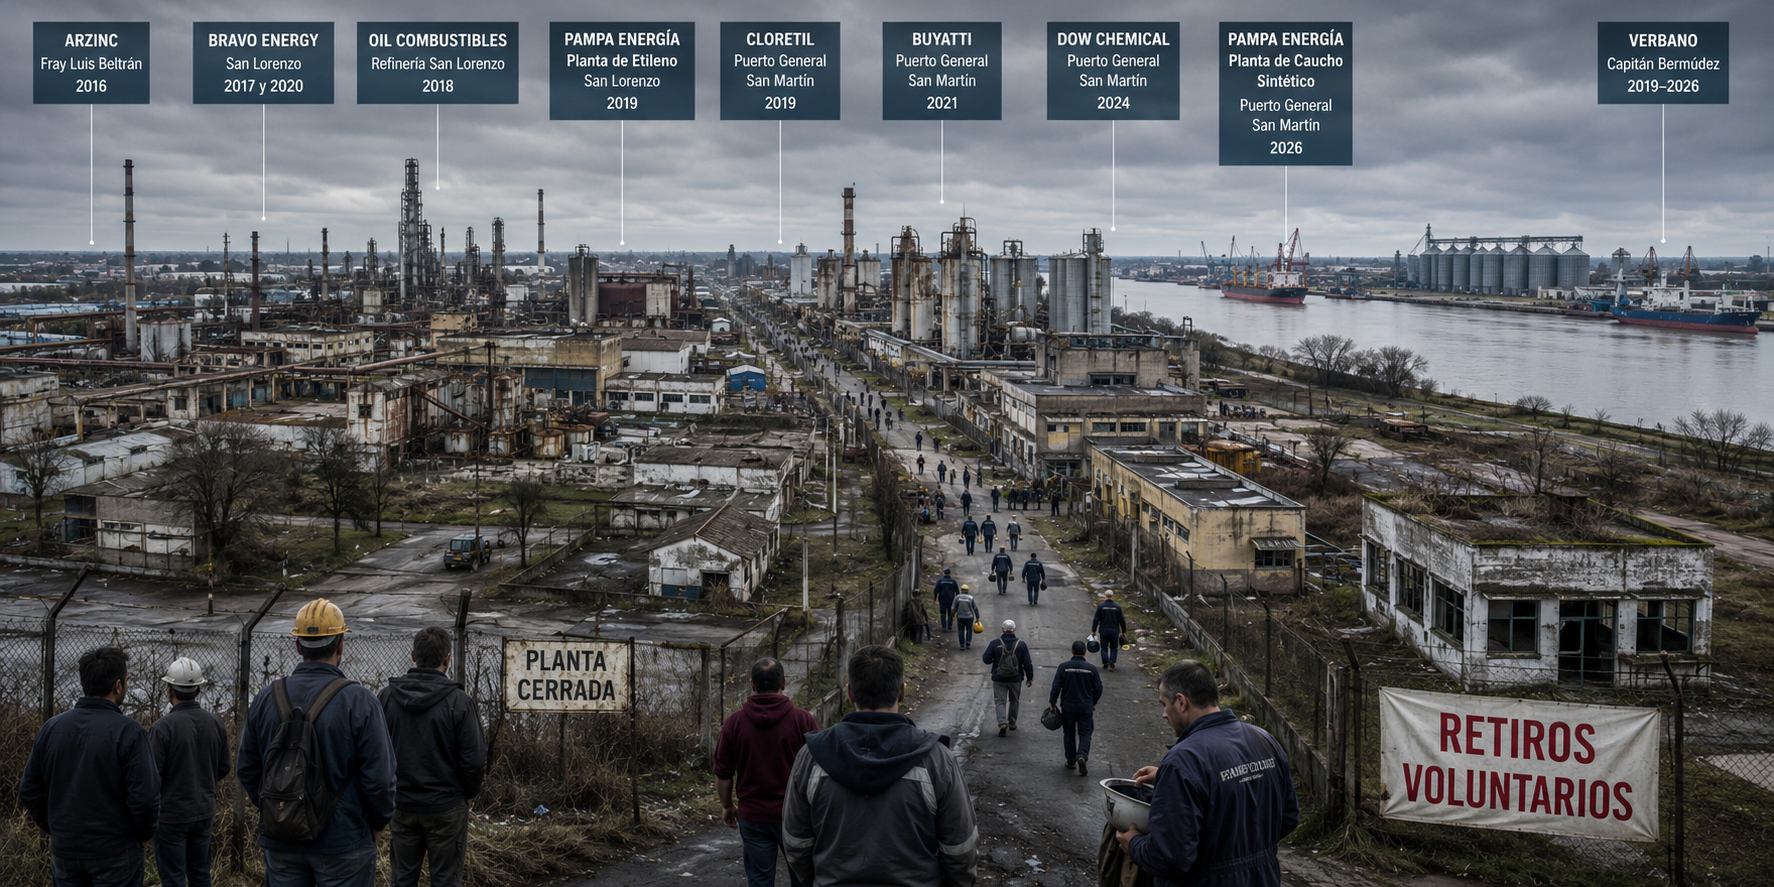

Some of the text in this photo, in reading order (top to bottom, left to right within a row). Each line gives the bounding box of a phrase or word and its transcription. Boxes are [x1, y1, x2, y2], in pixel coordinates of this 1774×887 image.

[526, 649, 607, 672] PLANTA
[517, 678, 616, 701] CERRADA
[1439, 711, 1597, 765] RETIROS
[1402, 762, 1634, 822] VOLUNTARIOS
